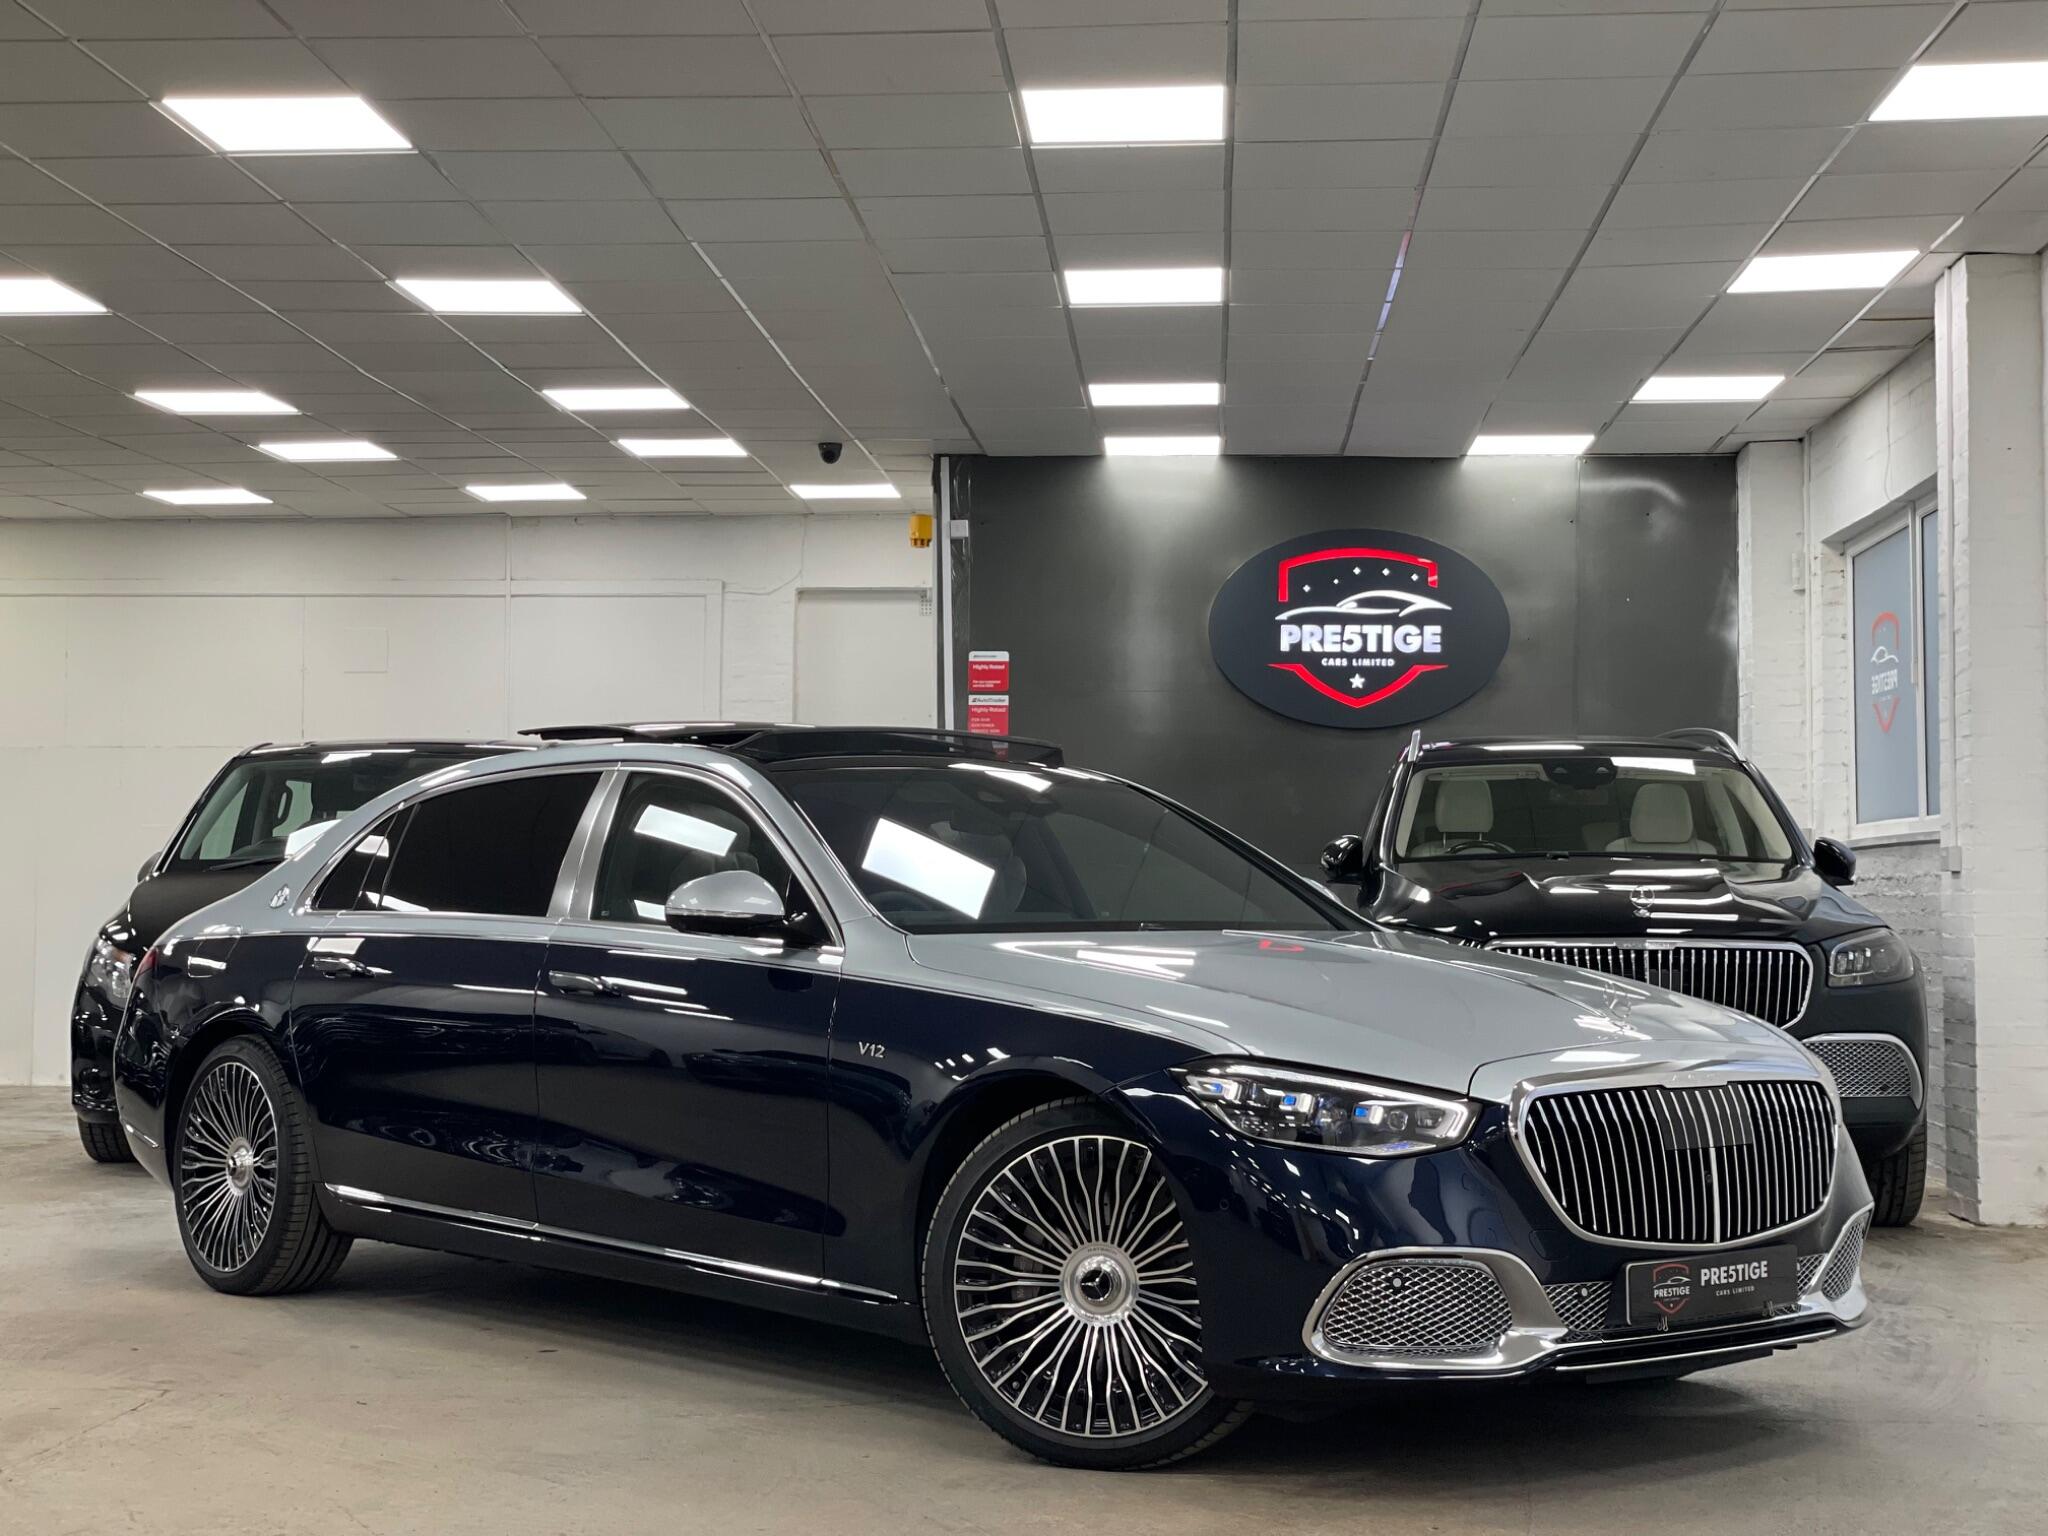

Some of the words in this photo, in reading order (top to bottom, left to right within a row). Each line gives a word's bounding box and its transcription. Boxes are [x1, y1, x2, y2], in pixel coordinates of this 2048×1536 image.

[1280, 624, 1442, 653] PRE5TIGE
[1321, 657, 1348, 667] CARS
[1352, 657, 1395, 667] LIMITED
[858, 1041, 885, 1058] V12
[1701, 1260, 1768, 1287] PRE5TIGE
[1716, 1289, 1731, 1297] CARS
[1732, 1285, 1755, 1295] LIMITED
